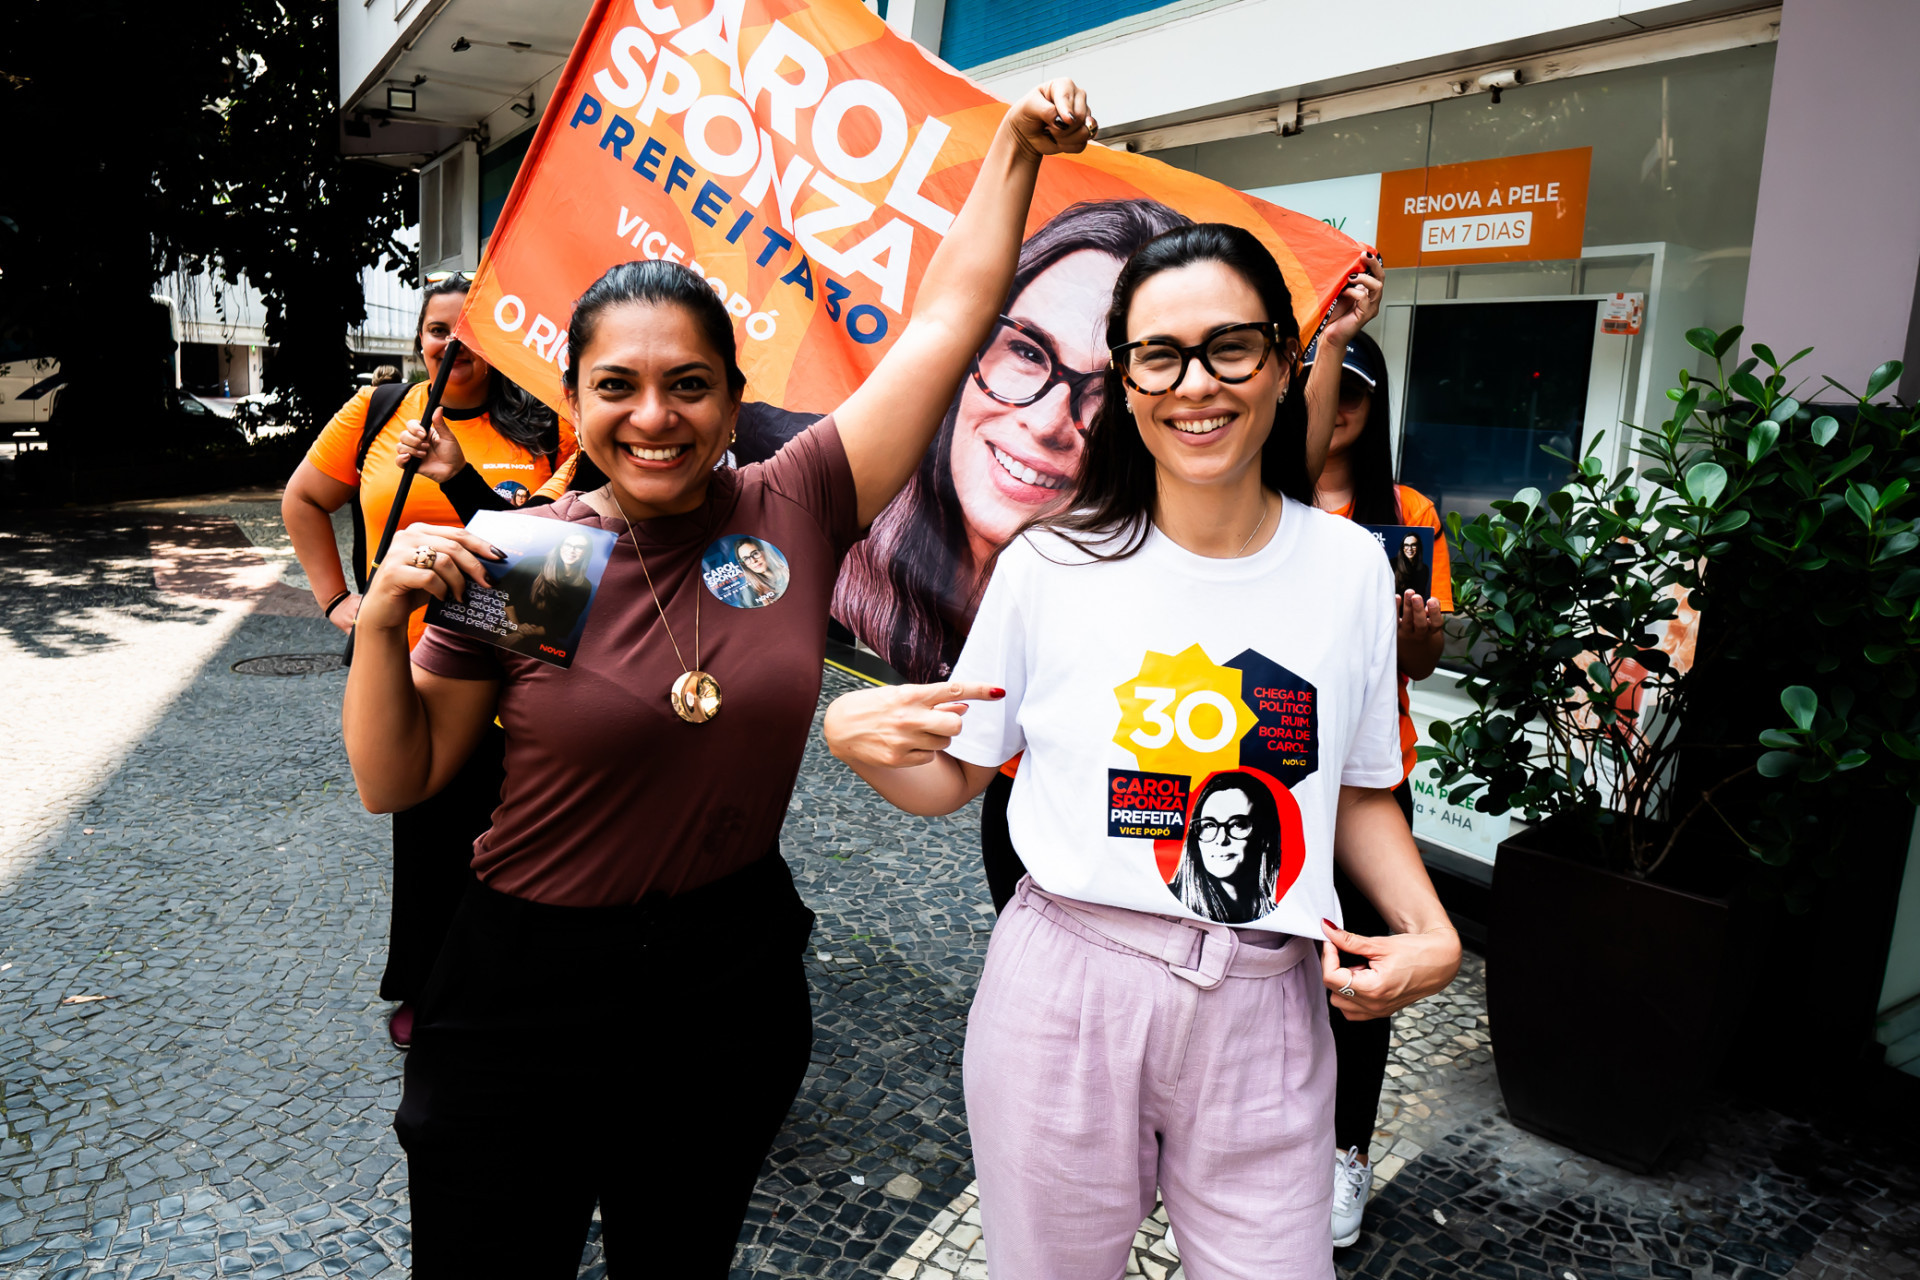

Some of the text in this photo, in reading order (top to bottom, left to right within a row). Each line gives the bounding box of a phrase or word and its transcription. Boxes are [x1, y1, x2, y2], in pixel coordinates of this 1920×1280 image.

[593, 26, 914, 314] SPONZA
[1404, 182, 1560, 215] RENOVA A PELE
[616, 205, 686, 264] VICE
[1428, 219, 1525, 245] EM 7 DIAS
[494, 294, 526, 333] O
[703, 561, 740, 581] CAROL
[539, 643, 567, 658] NOVO
[1253, 686, 1312, 703] CHEGA DE
[1259, 699, 1312, 715] POLÍTICO
[1128, 686, 1238, 754] 30
[1281, 715, 1311, 728] RUIM.
[1258, 726, 1310, 741] BORA DE
[1283, 758, 1307, 767] NOVO
[1111, 776, 1186, 797] CAROL
[1414, 779, 1434, 798] NA
[1111, 793, 1184, 811] SPONZA
[1110, 808, 1184, 826] PREFEITA
[1441, 810, 1473, 832] AHA
[1119, 826, 1171, 837] VICE POPÓ
